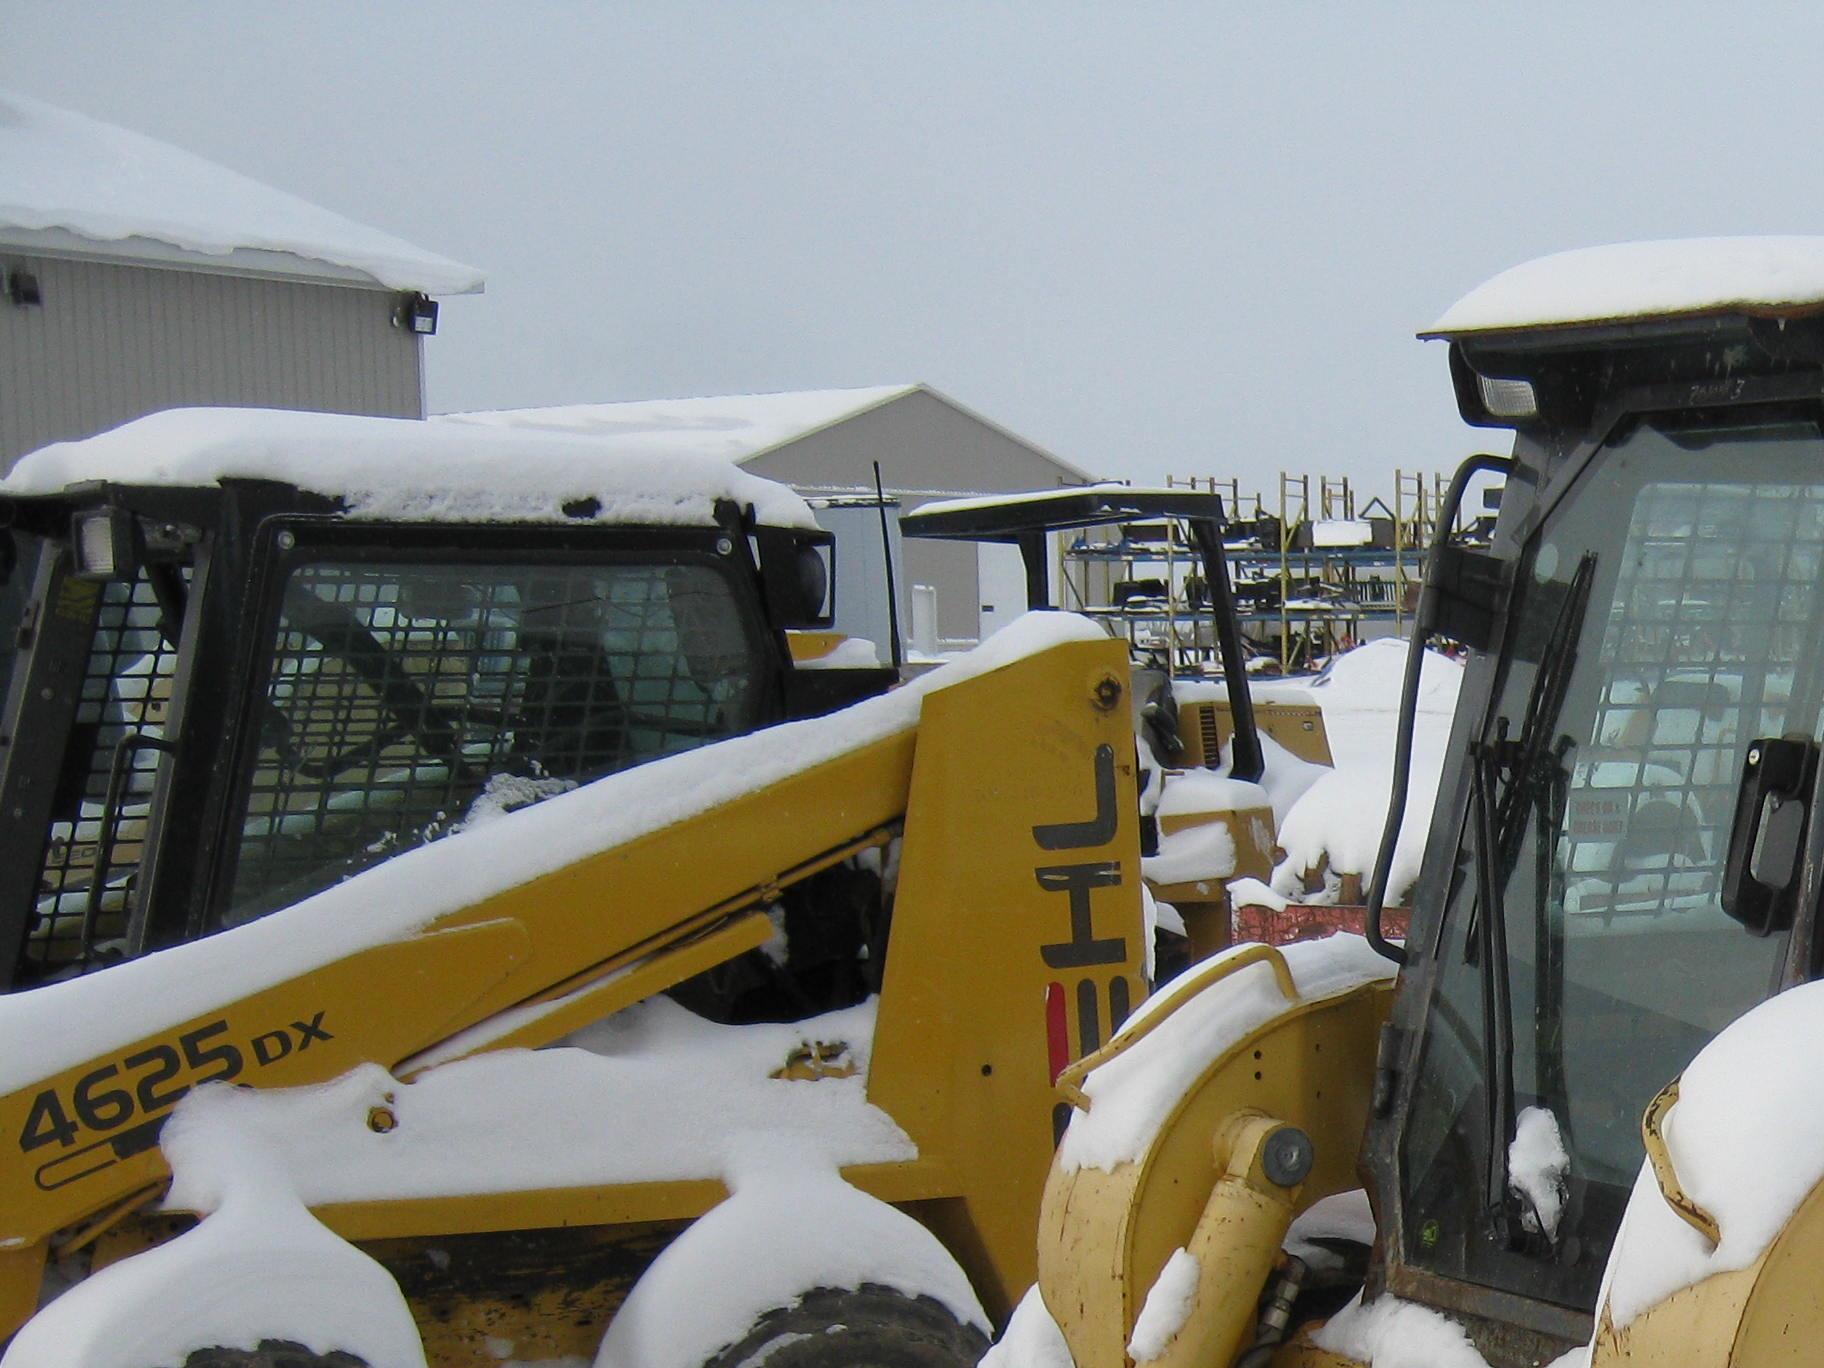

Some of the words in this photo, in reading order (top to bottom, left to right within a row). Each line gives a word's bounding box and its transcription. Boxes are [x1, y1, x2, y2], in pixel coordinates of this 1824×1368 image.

[19, 1019, 243, 1153] 4625
[250, 1010, 335, 1067] DX
[1031, 743, 1130, 1151] EHL
